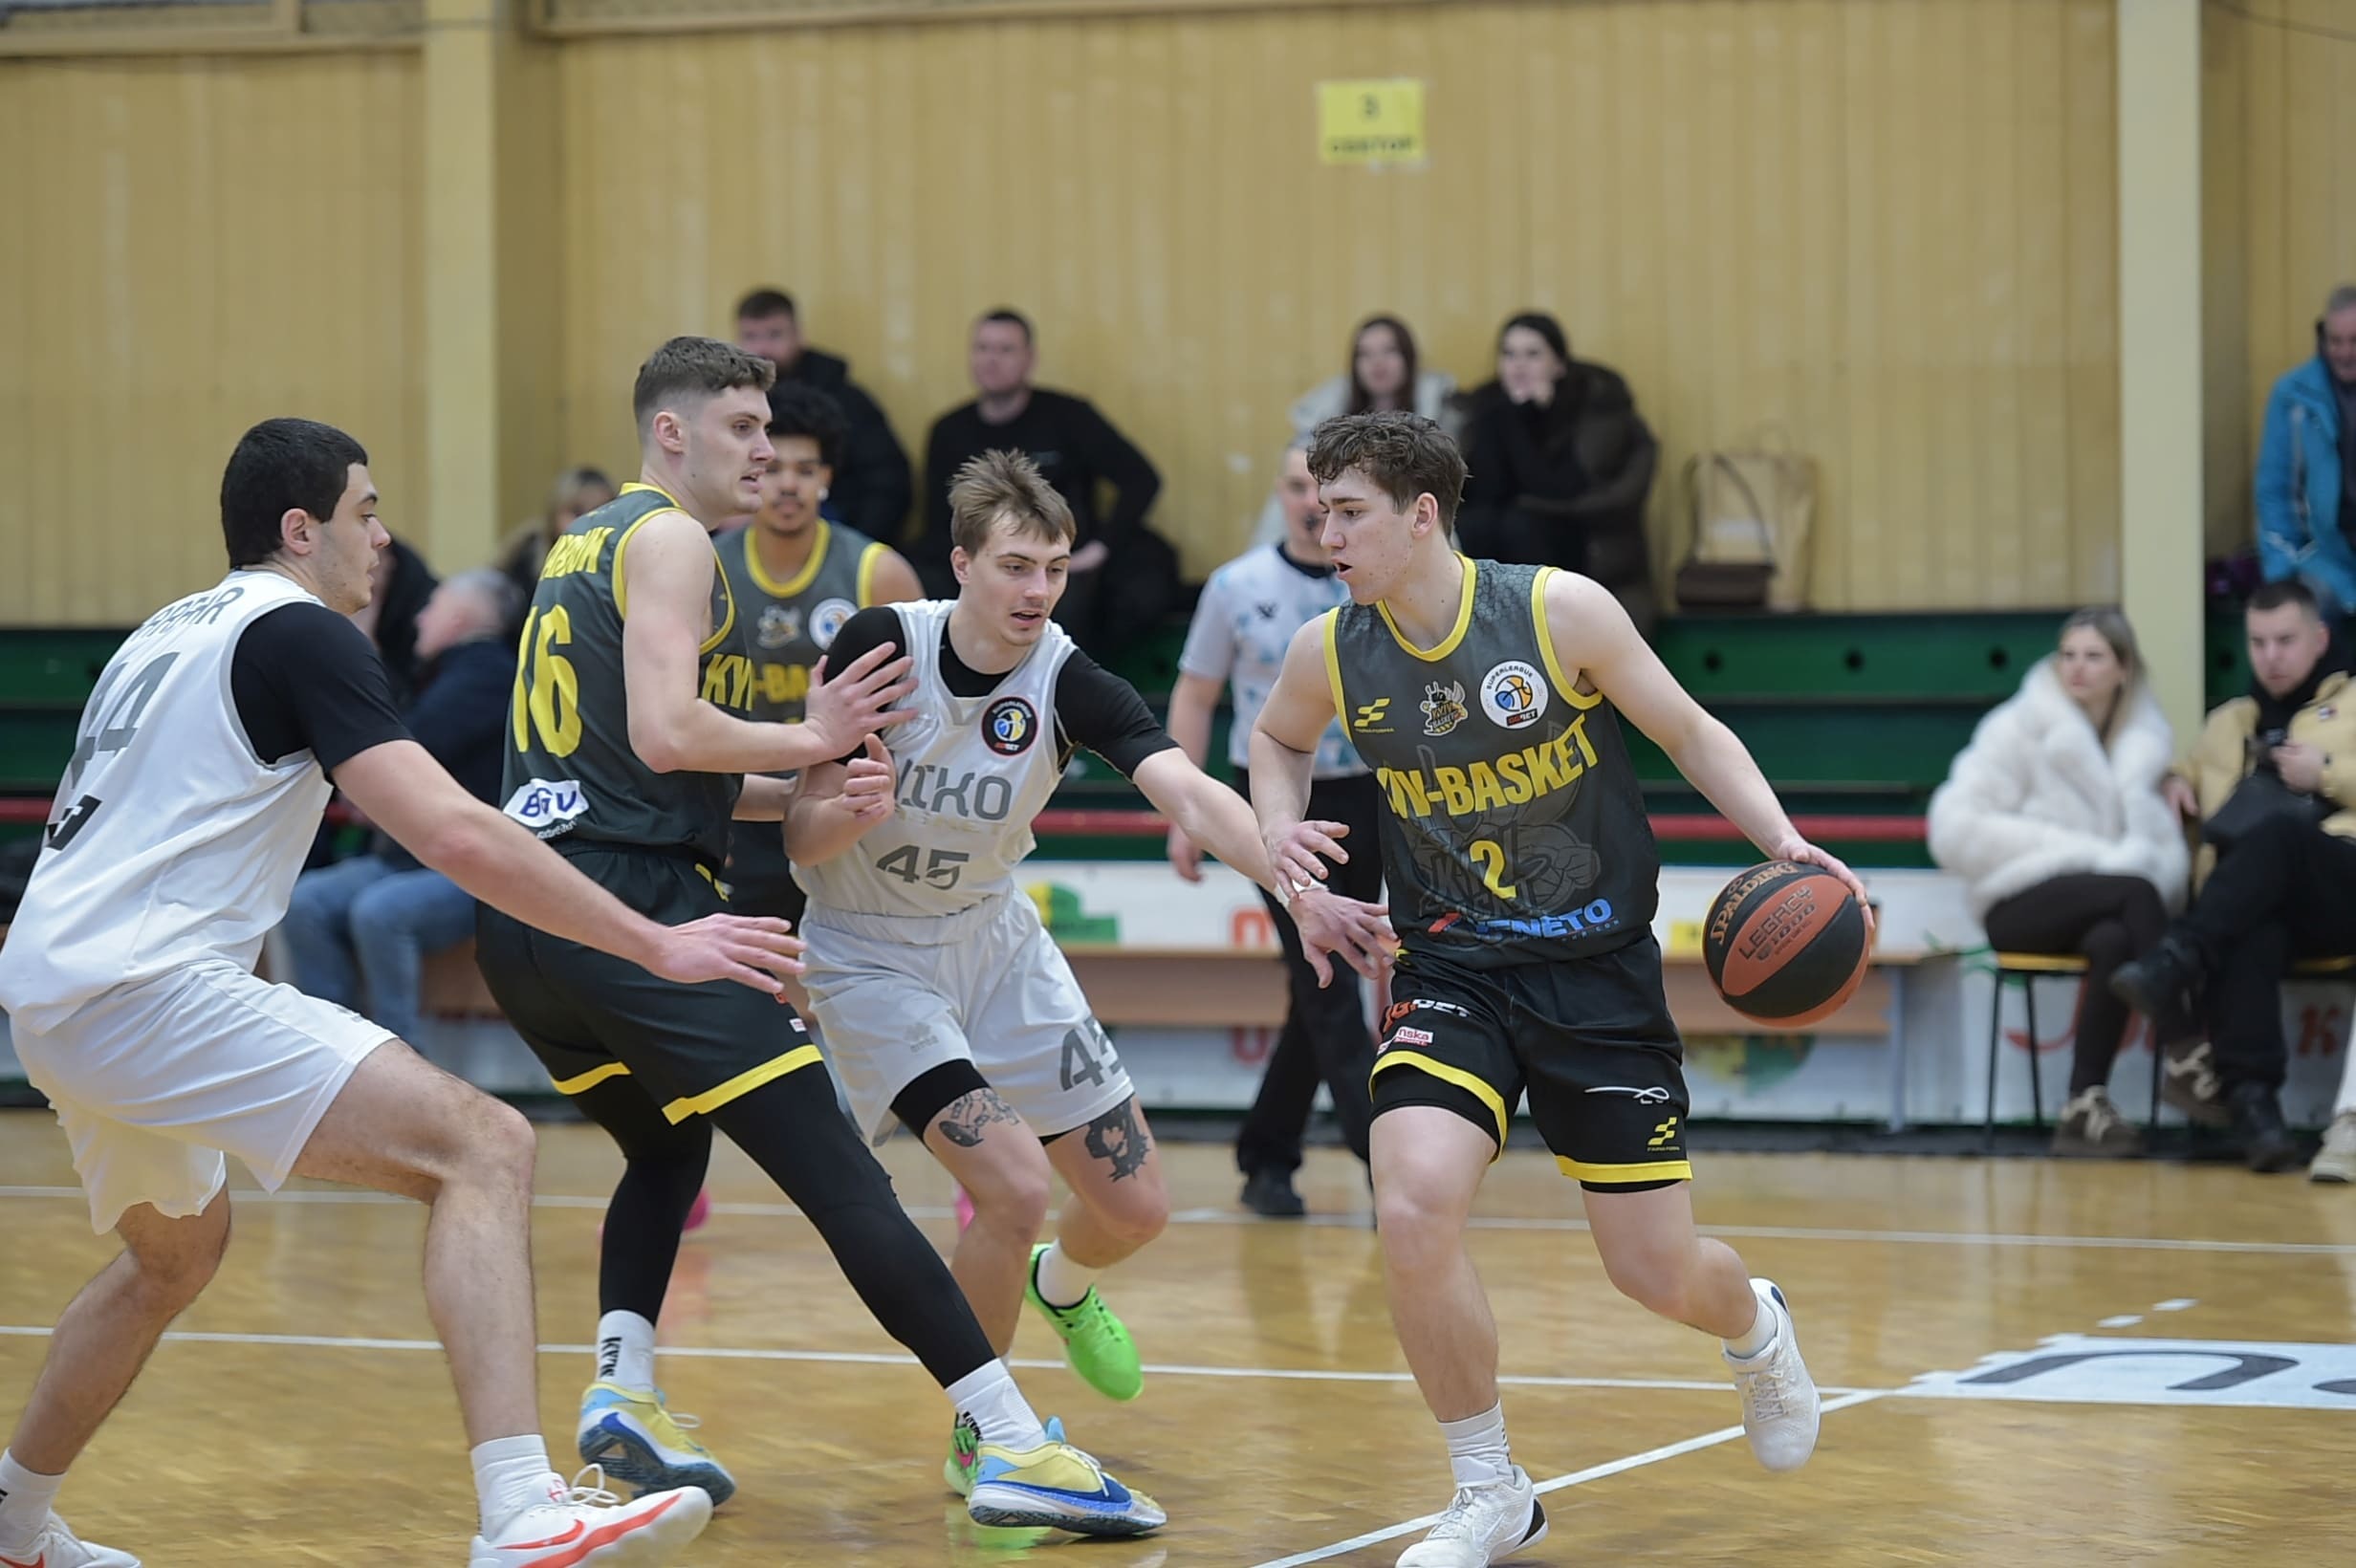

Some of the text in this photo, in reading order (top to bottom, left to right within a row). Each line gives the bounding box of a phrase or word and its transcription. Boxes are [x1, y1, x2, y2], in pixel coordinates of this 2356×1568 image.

[513, 604, 582, 758] 16
[519, 787, 578, 818] BGV
[876, 843, 971, 890] 45
[1469, 839, 1517, 900] 2
[1476, 899, 1614, 939] NETO
[1710, 861, 1799, 946] SPALDING
[1738, 884, 1814, 960] LEGACY
